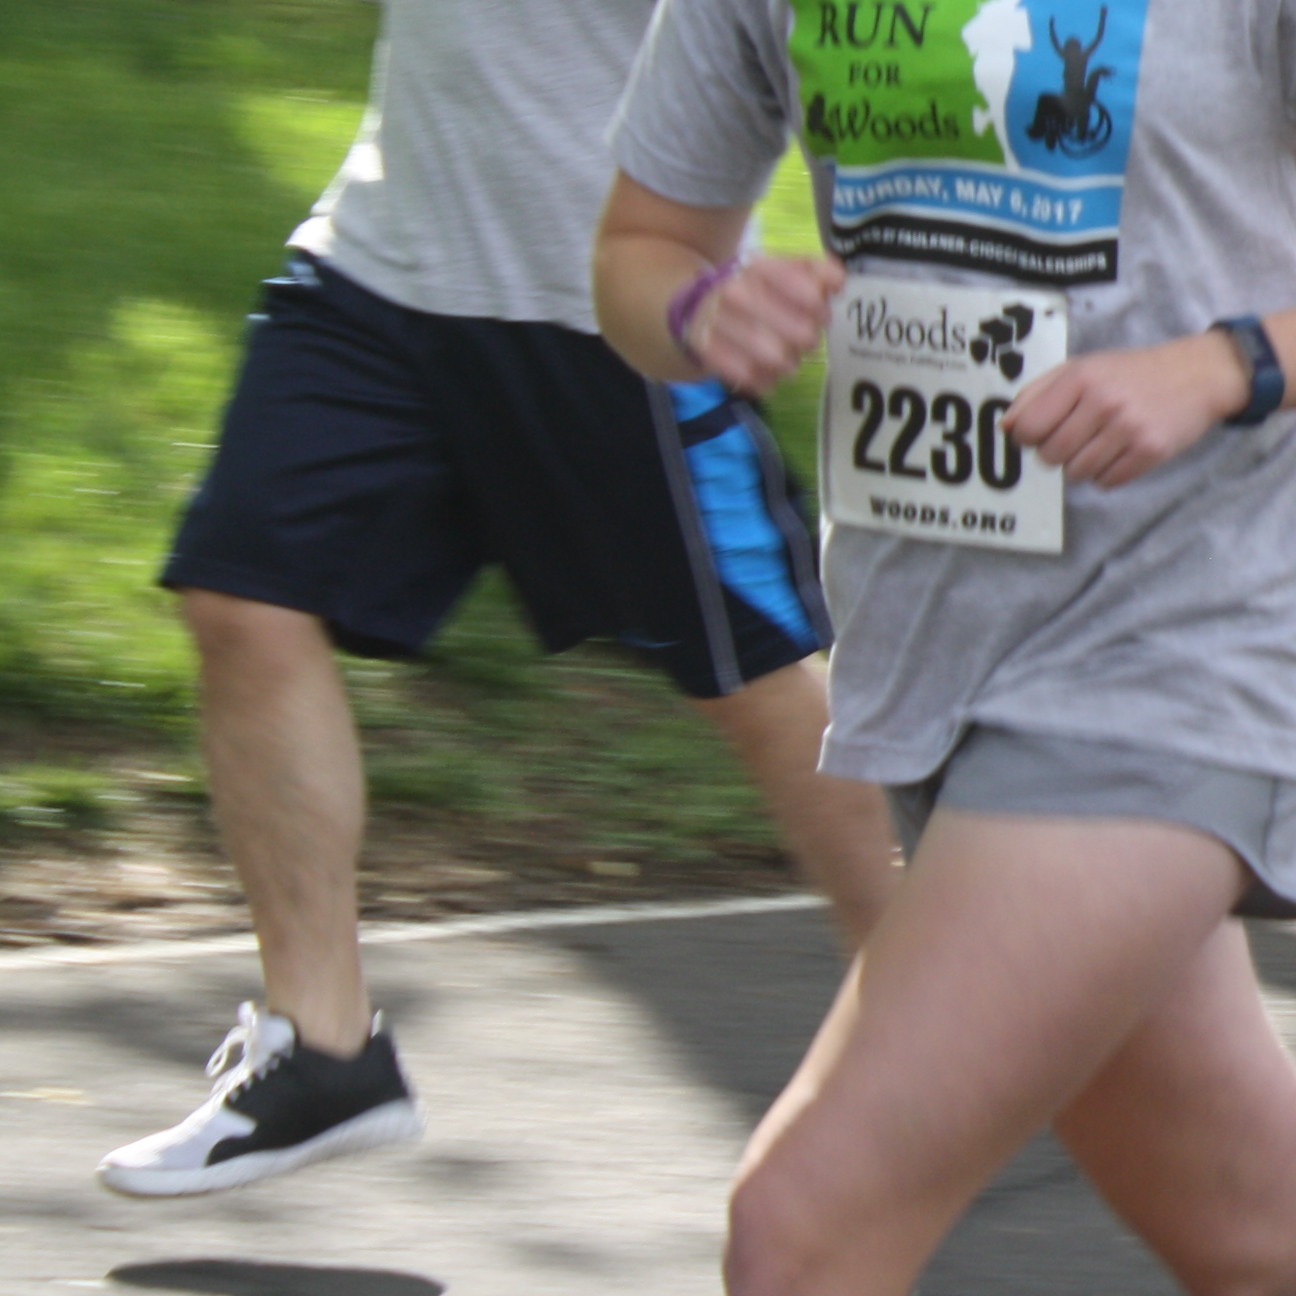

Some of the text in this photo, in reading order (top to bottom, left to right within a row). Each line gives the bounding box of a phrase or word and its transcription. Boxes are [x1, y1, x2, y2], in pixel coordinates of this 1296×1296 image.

[817, 1, 933, 49] RUN
[848, 61, 901, 91] FOR
[829, 98, 960, 144] Woods
[834, 175, 948, 211] ATURDAY,
[955, 177, 1003, 207] MAY
[846, 296, 967, 353] Woods
[851, 379, 1023, 492] 2230
[869, 495, 1017, 535] WOODS.ORG
